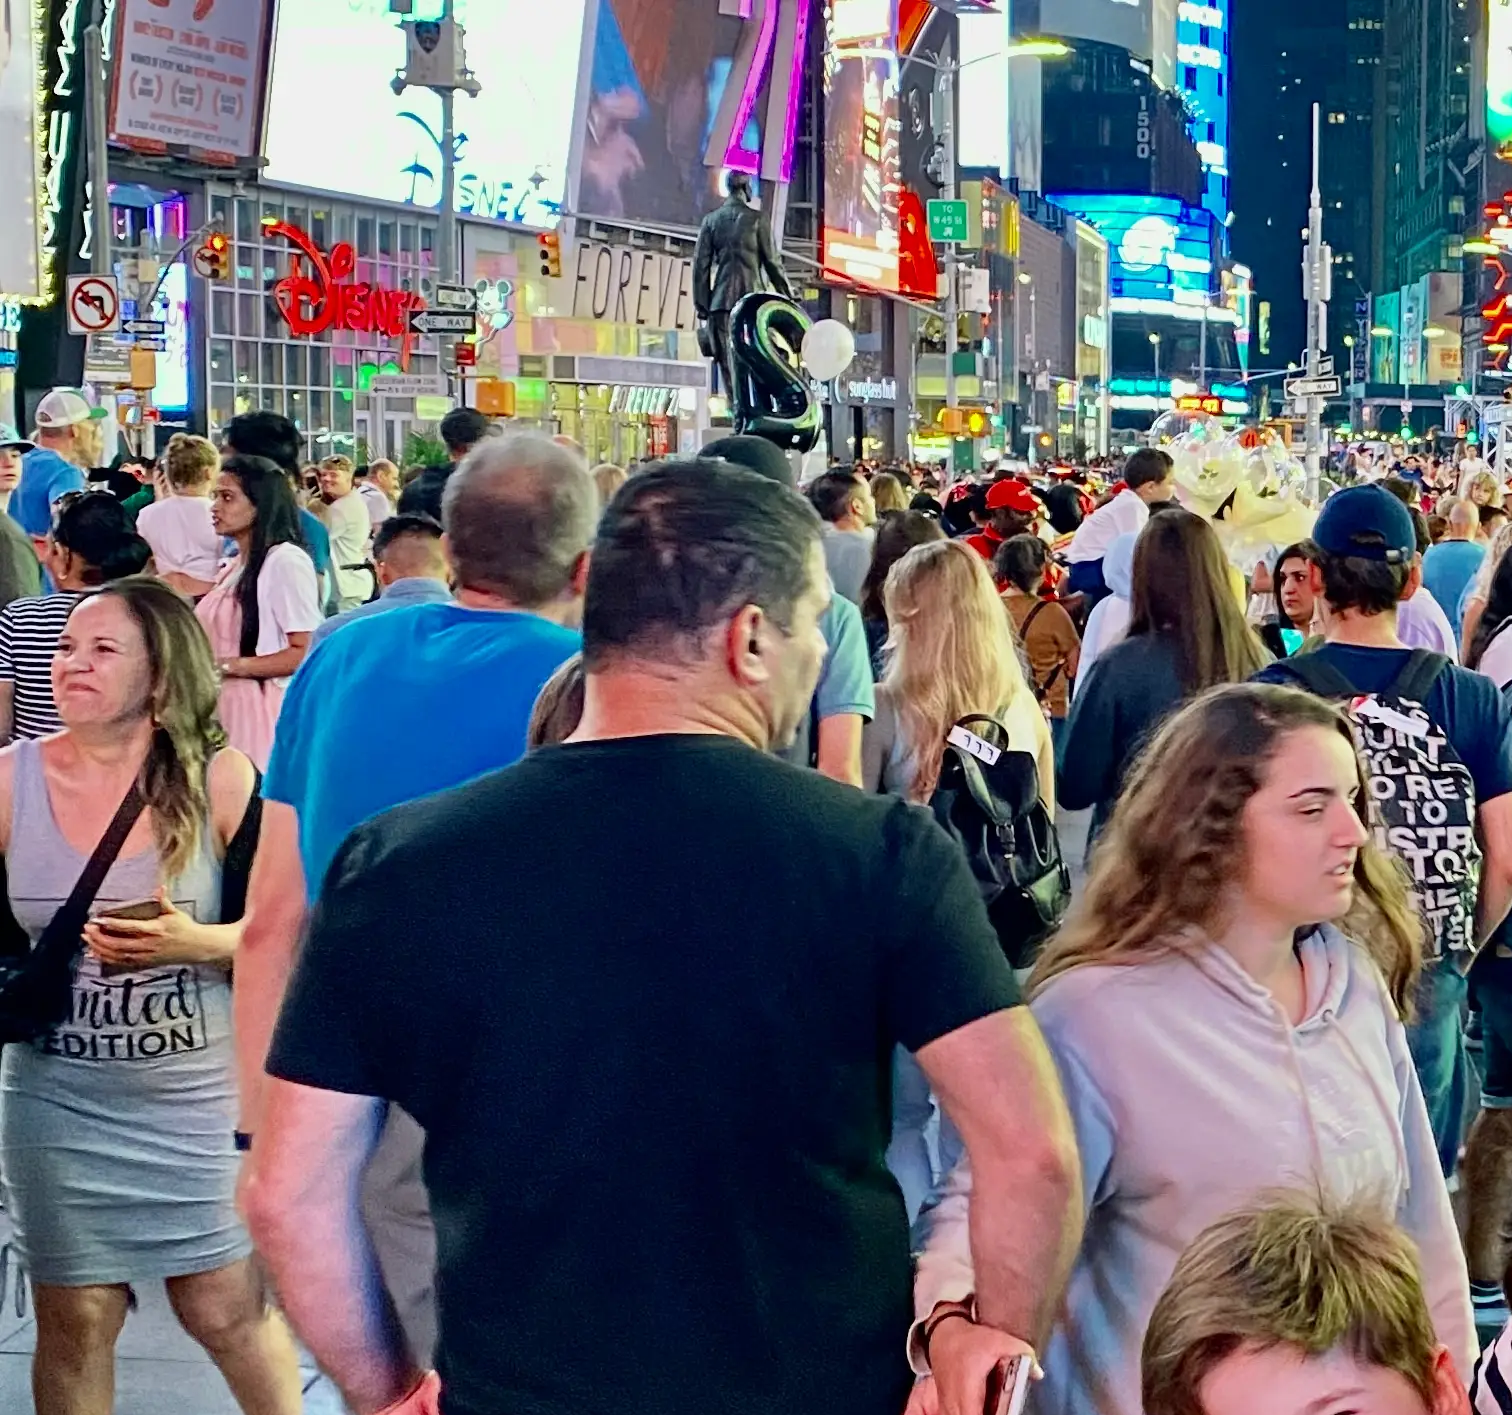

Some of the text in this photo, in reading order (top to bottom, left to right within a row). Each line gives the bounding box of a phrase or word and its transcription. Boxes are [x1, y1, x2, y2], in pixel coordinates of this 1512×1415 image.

[1136, 95, 1150, 159] 1500
[942, 204, 953, 214] TO
[572, 243, 697, 330] FOREVE
[418, 317, 468, 328] ONE WAY
[608, 384, 670, 415] FOREVER
[849, 377, 882, 404] sunglass
[882, 377, 897, 401] hut
